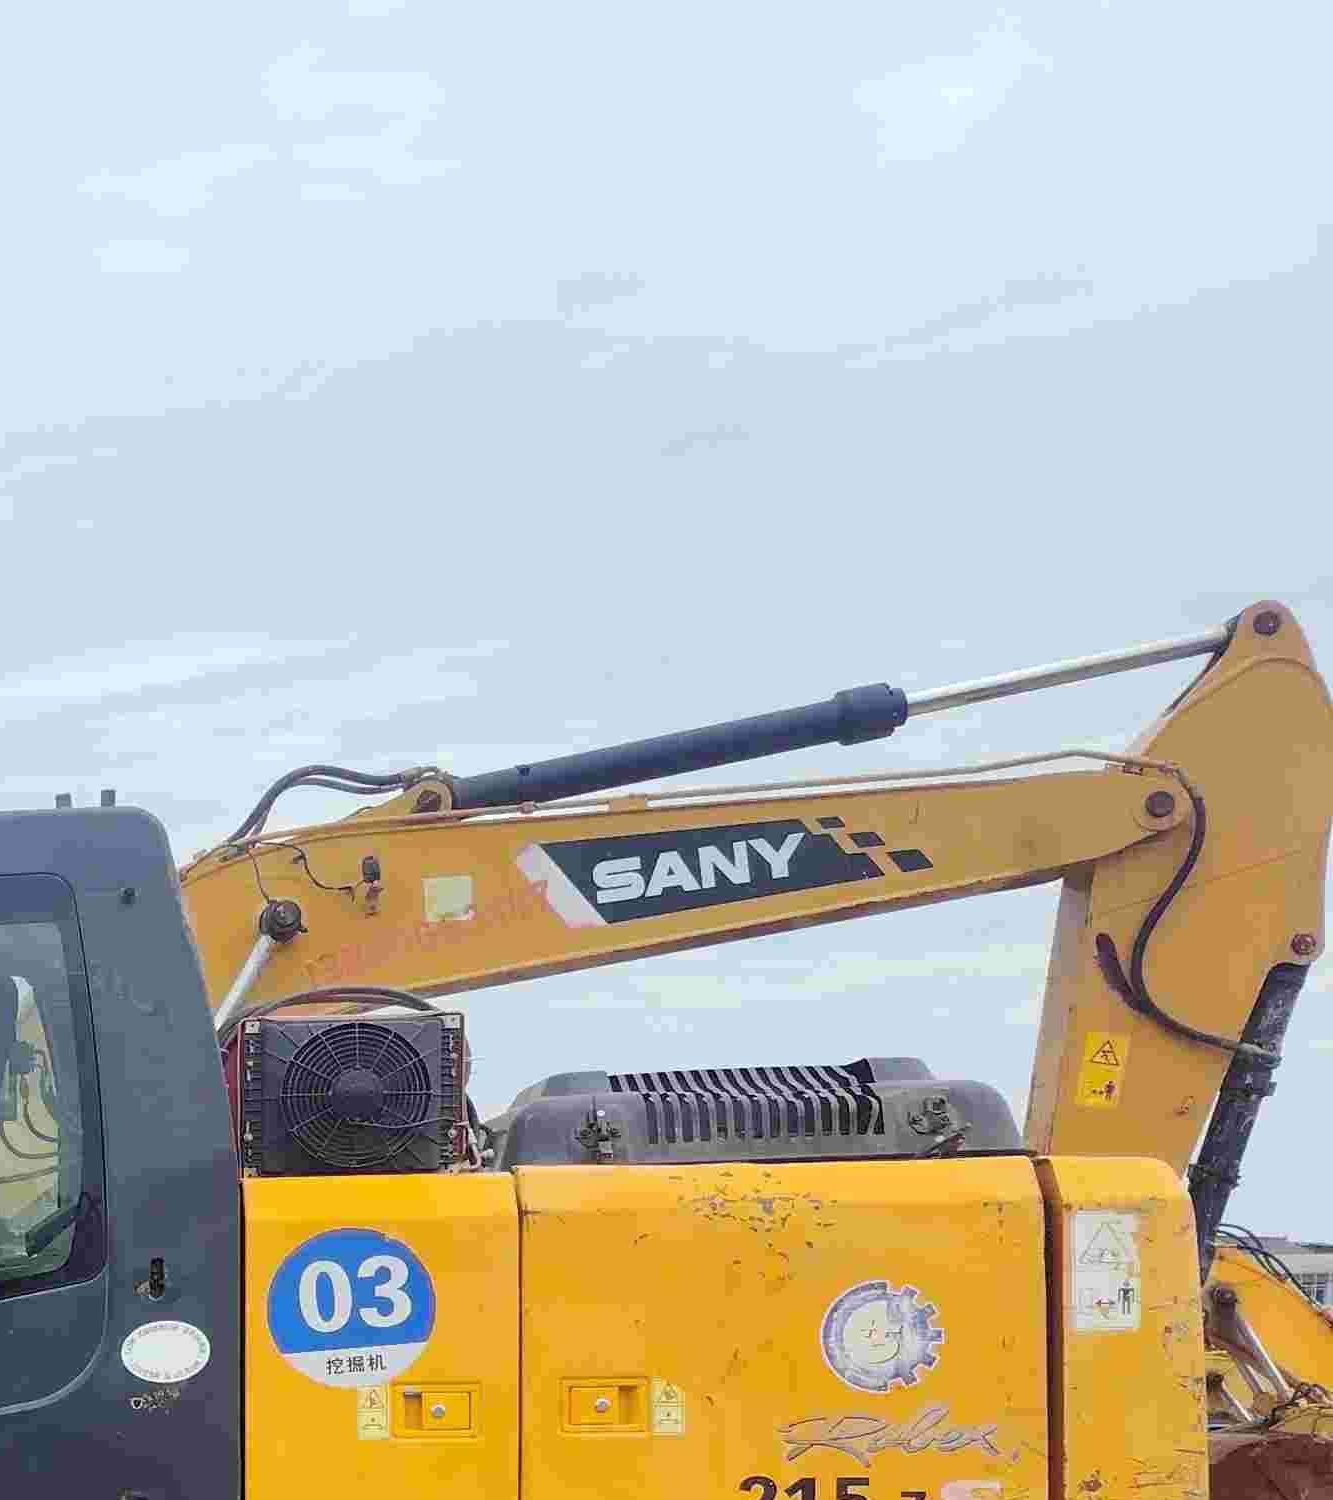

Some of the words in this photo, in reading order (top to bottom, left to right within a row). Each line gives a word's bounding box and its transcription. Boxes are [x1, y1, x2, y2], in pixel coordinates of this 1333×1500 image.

[592, 832, 806, 904] SANY
[299, 1255, 413, 1333] 03
[326, 1354, 387, 1376] 挖掘机
